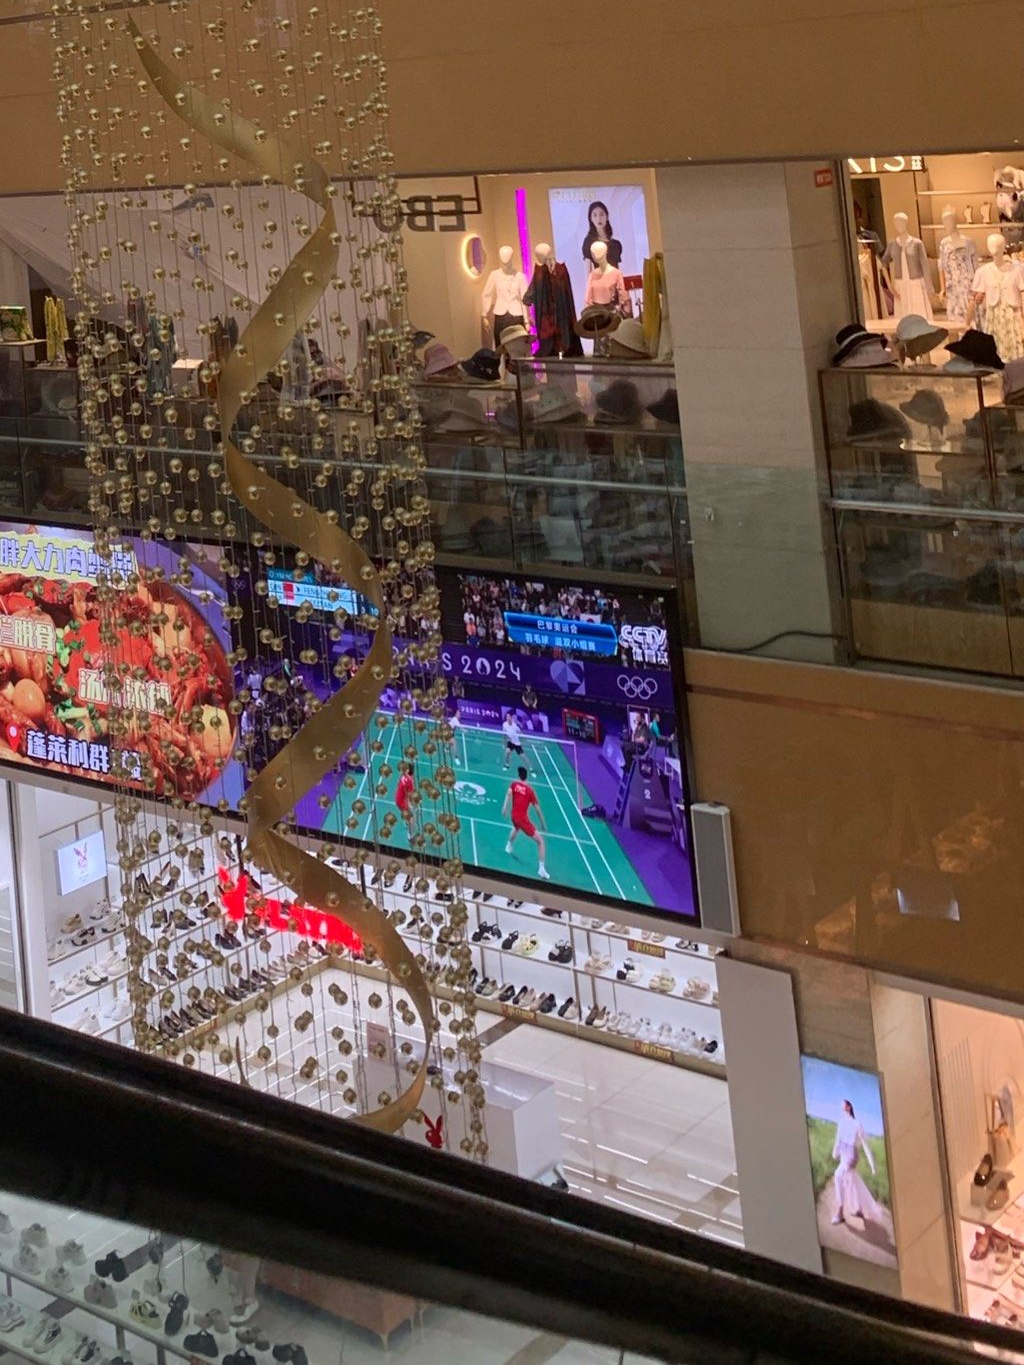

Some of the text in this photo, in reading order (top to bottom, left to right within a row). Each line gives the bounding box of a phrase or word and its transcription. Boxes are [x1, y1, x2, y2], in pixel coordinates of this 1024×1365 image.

[537, 619, 578, 634] 巴黎奥运会
[621, 624, 668, 646] CCTV
[525, 632, 549, 645] 羽毛球
[461, 654, 521, 682] 2024
